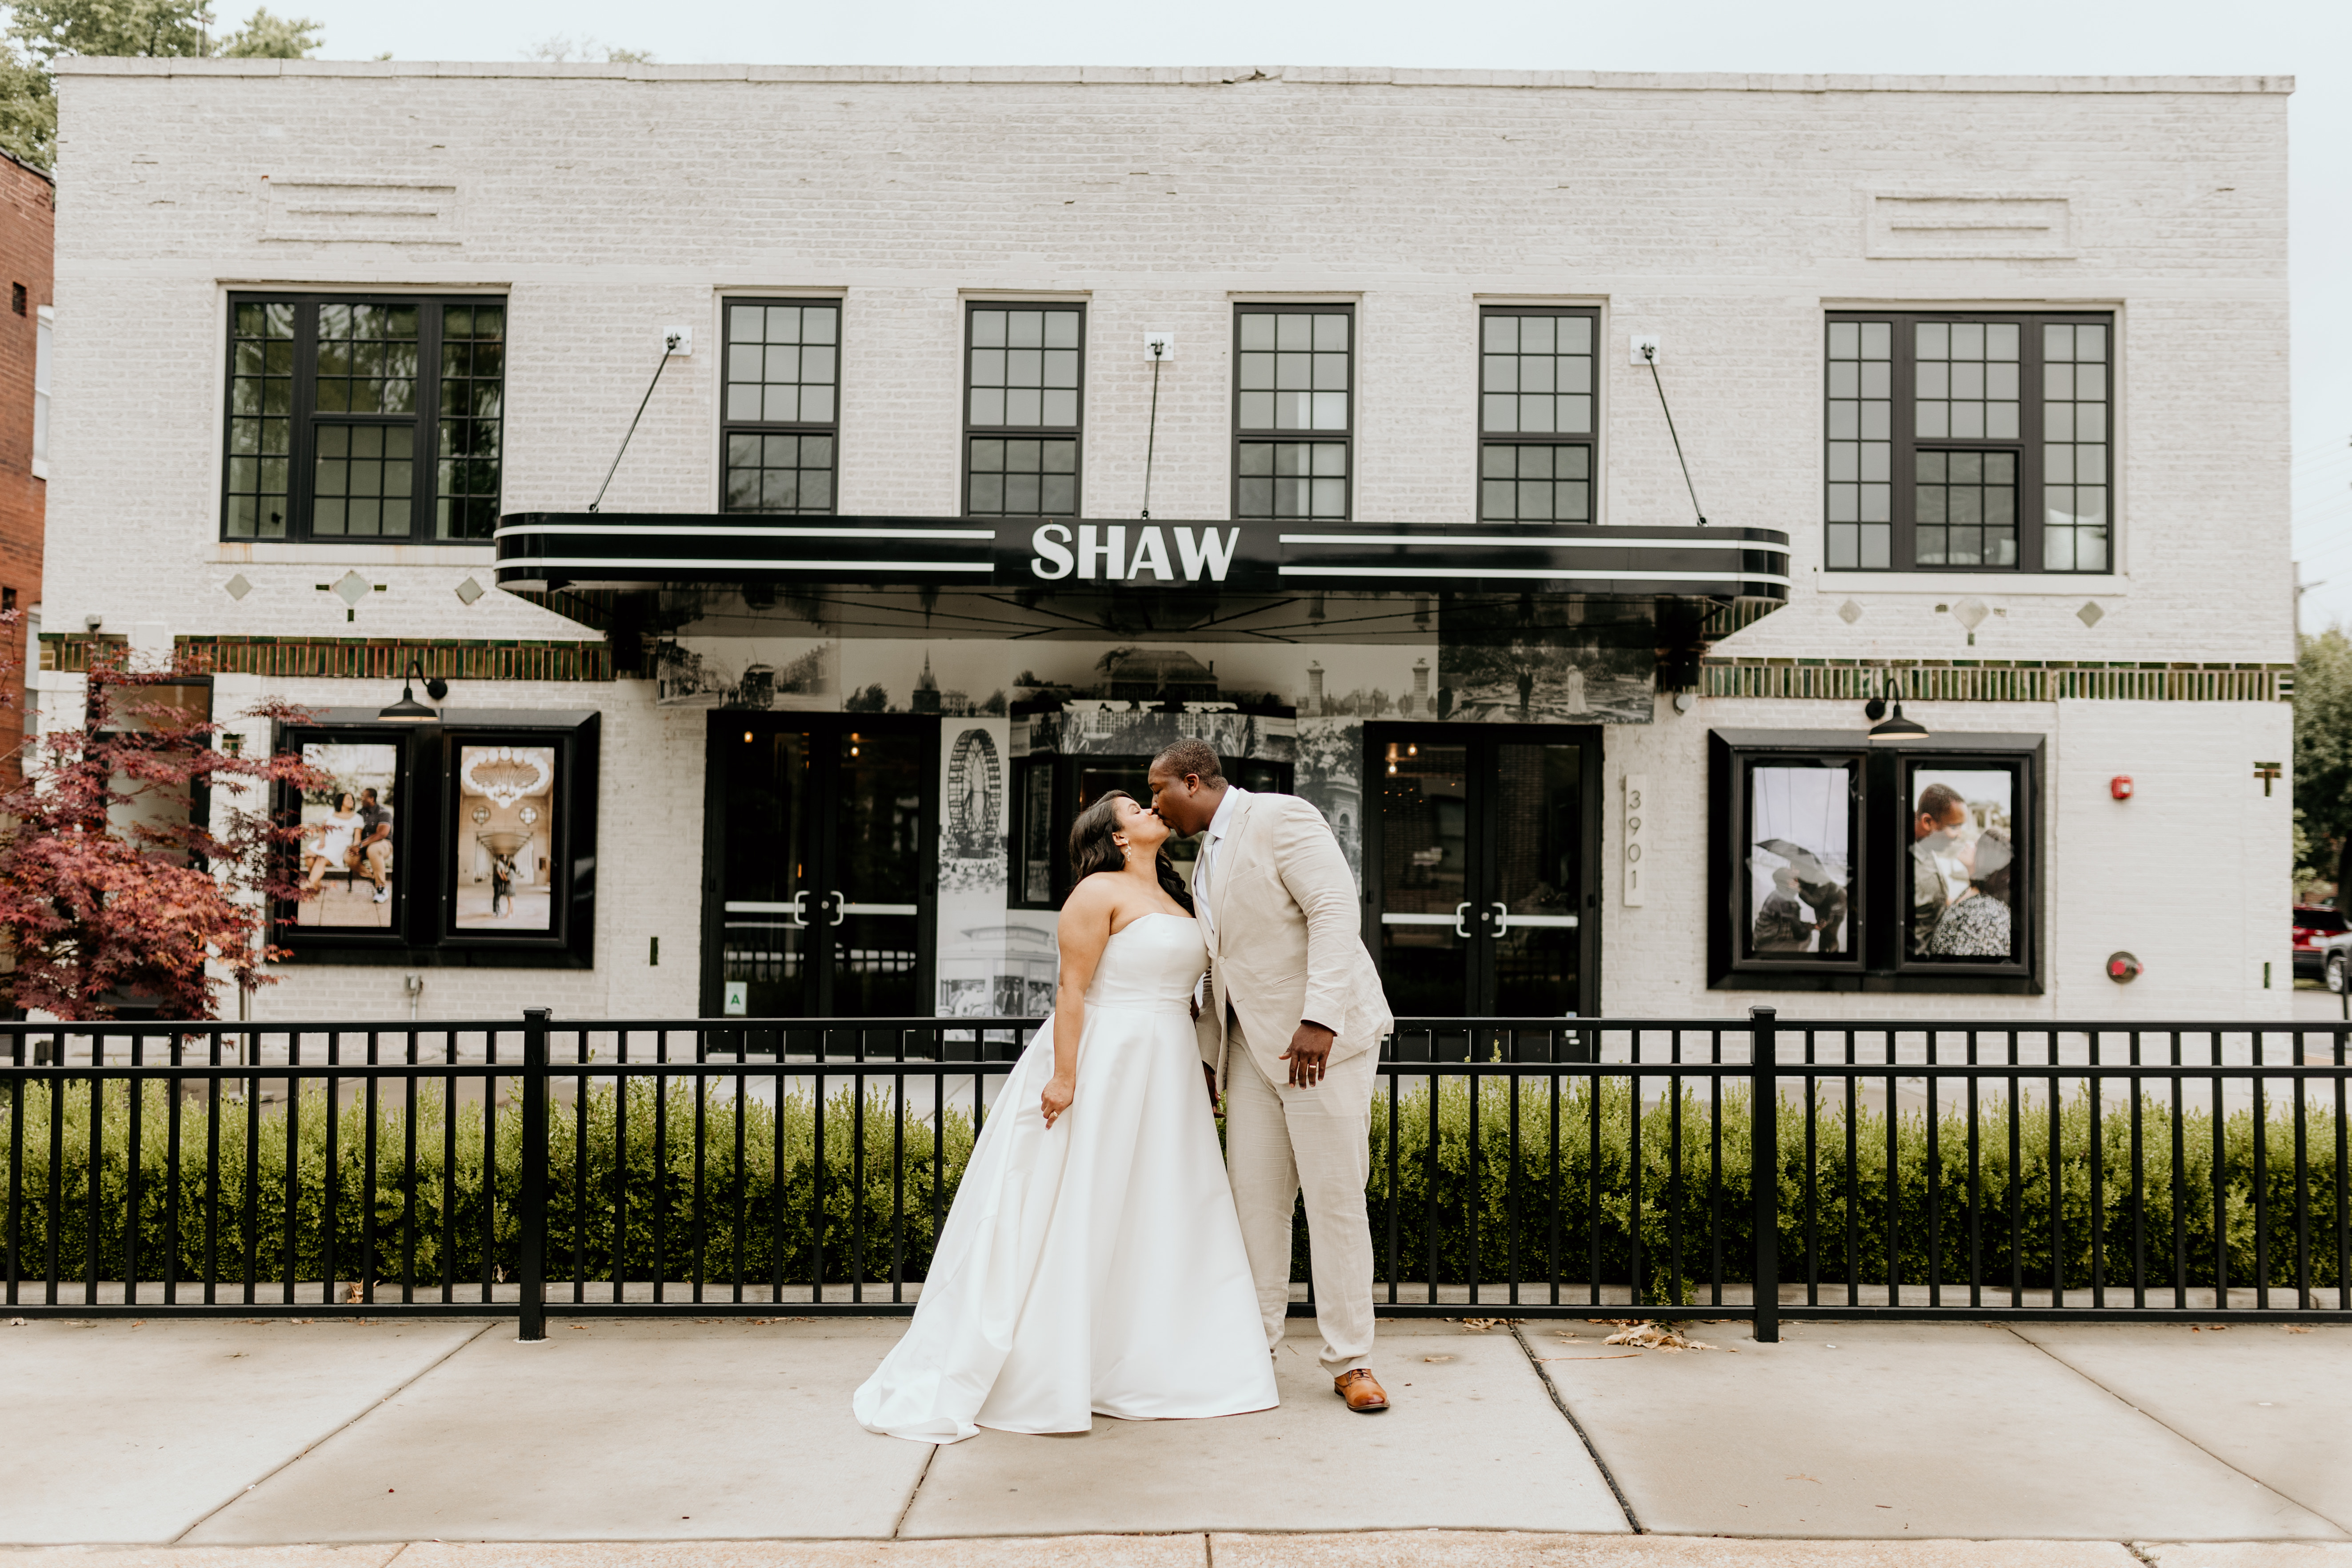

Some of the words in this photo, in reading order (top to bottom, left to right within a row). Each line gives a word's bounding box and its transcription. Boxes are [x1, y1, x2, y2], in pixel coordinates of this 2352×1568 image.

[1031, 524, 1240, 581] SHAW
[1628, 789, 1641, 889] 3901
[731, 994, 740, 1005] A
